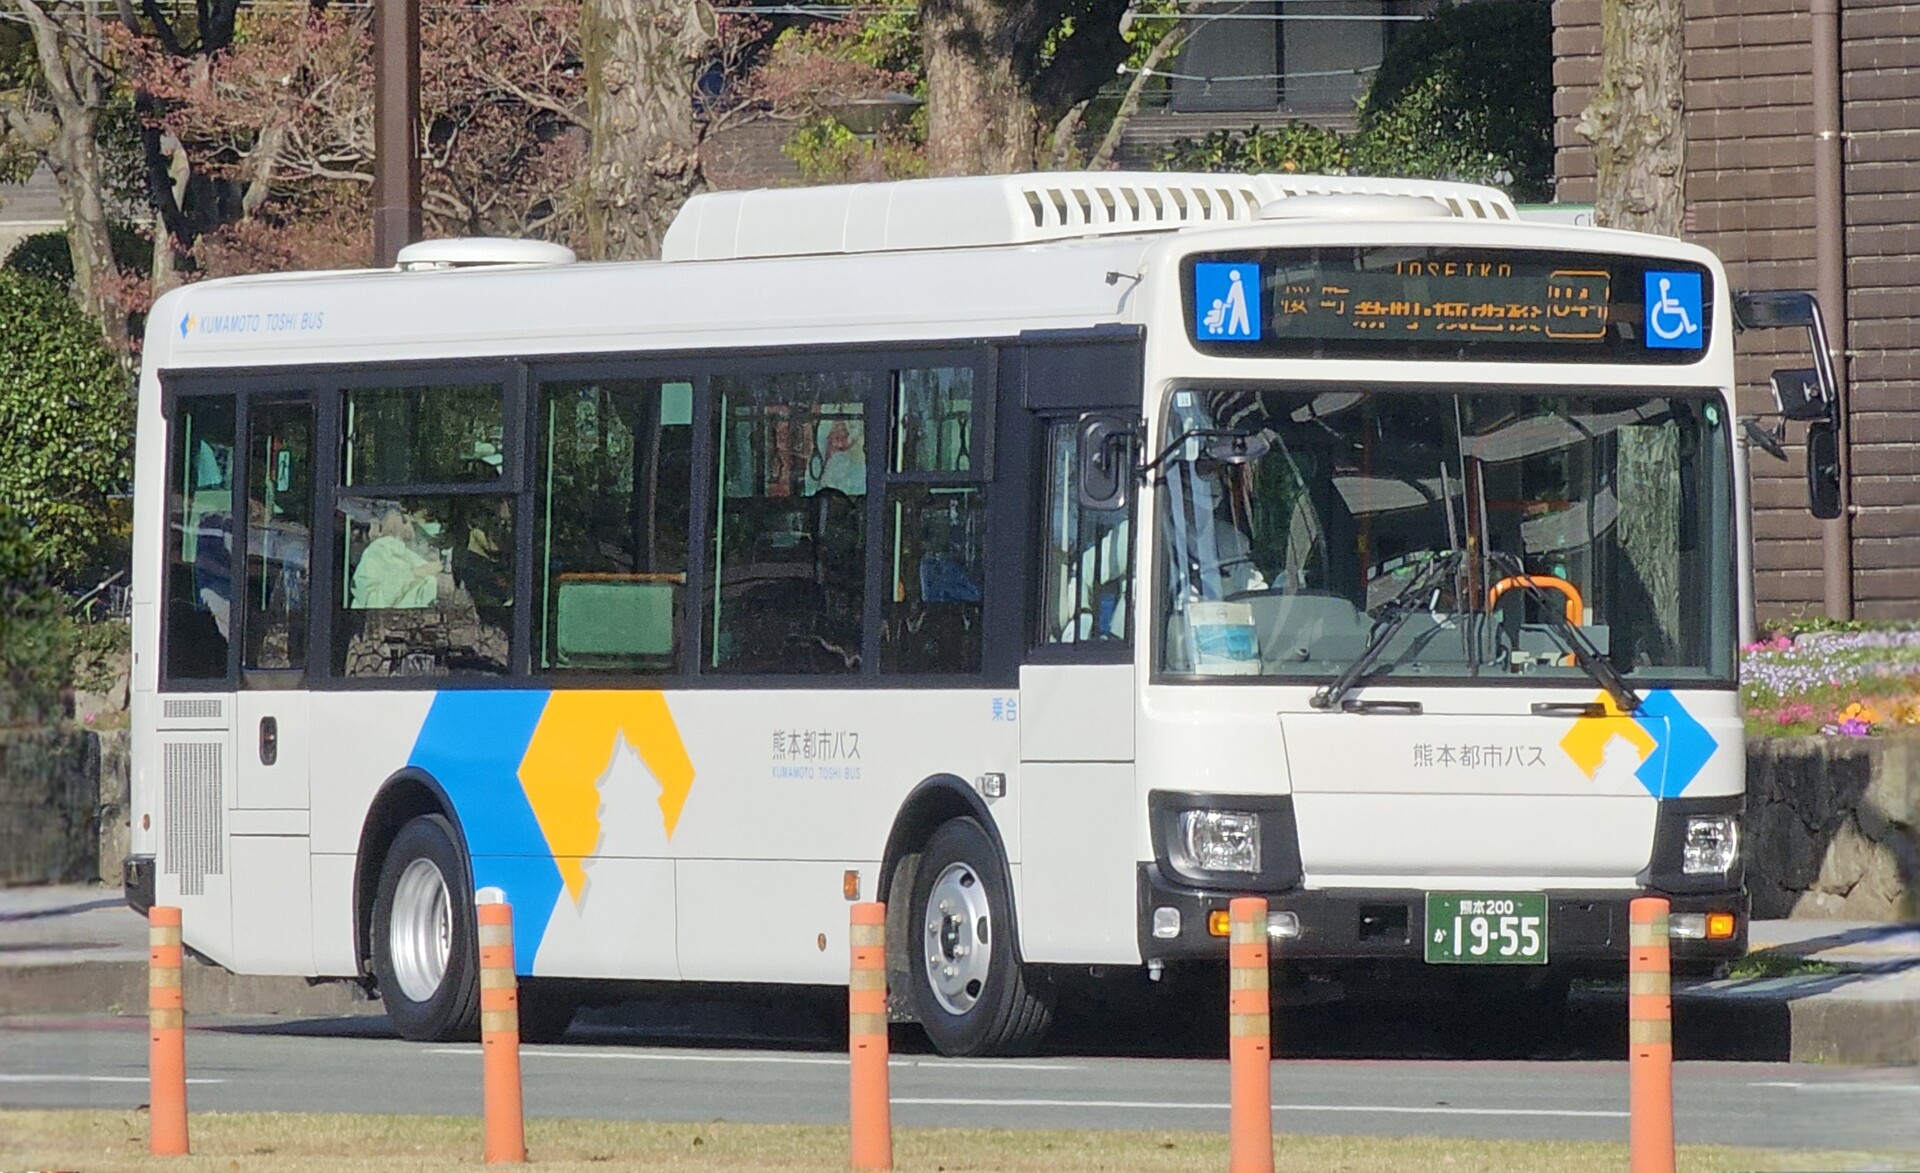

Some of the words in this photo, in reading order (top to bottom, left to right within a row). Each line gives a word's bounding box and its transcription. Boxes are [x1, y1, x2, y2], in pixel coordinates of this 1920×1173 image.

[199, 313, 261, 334] KUMAMOTO
[266, 313, 297, 331] TOSHI
[301, 311, 325, 330] BUS
[772, 728, 861, 762] 熊本都市バス
[1413, 742, 1546, 769] 熊本都市バス
[772, 766, 814, 780] KUMAMOTO
[819, 766, 841, 780] TOSHI
[844, 767, 861, 780] BUS
[1433, 928, 1447, 943] か
[1453, 916, 1540, 956] 19-55
